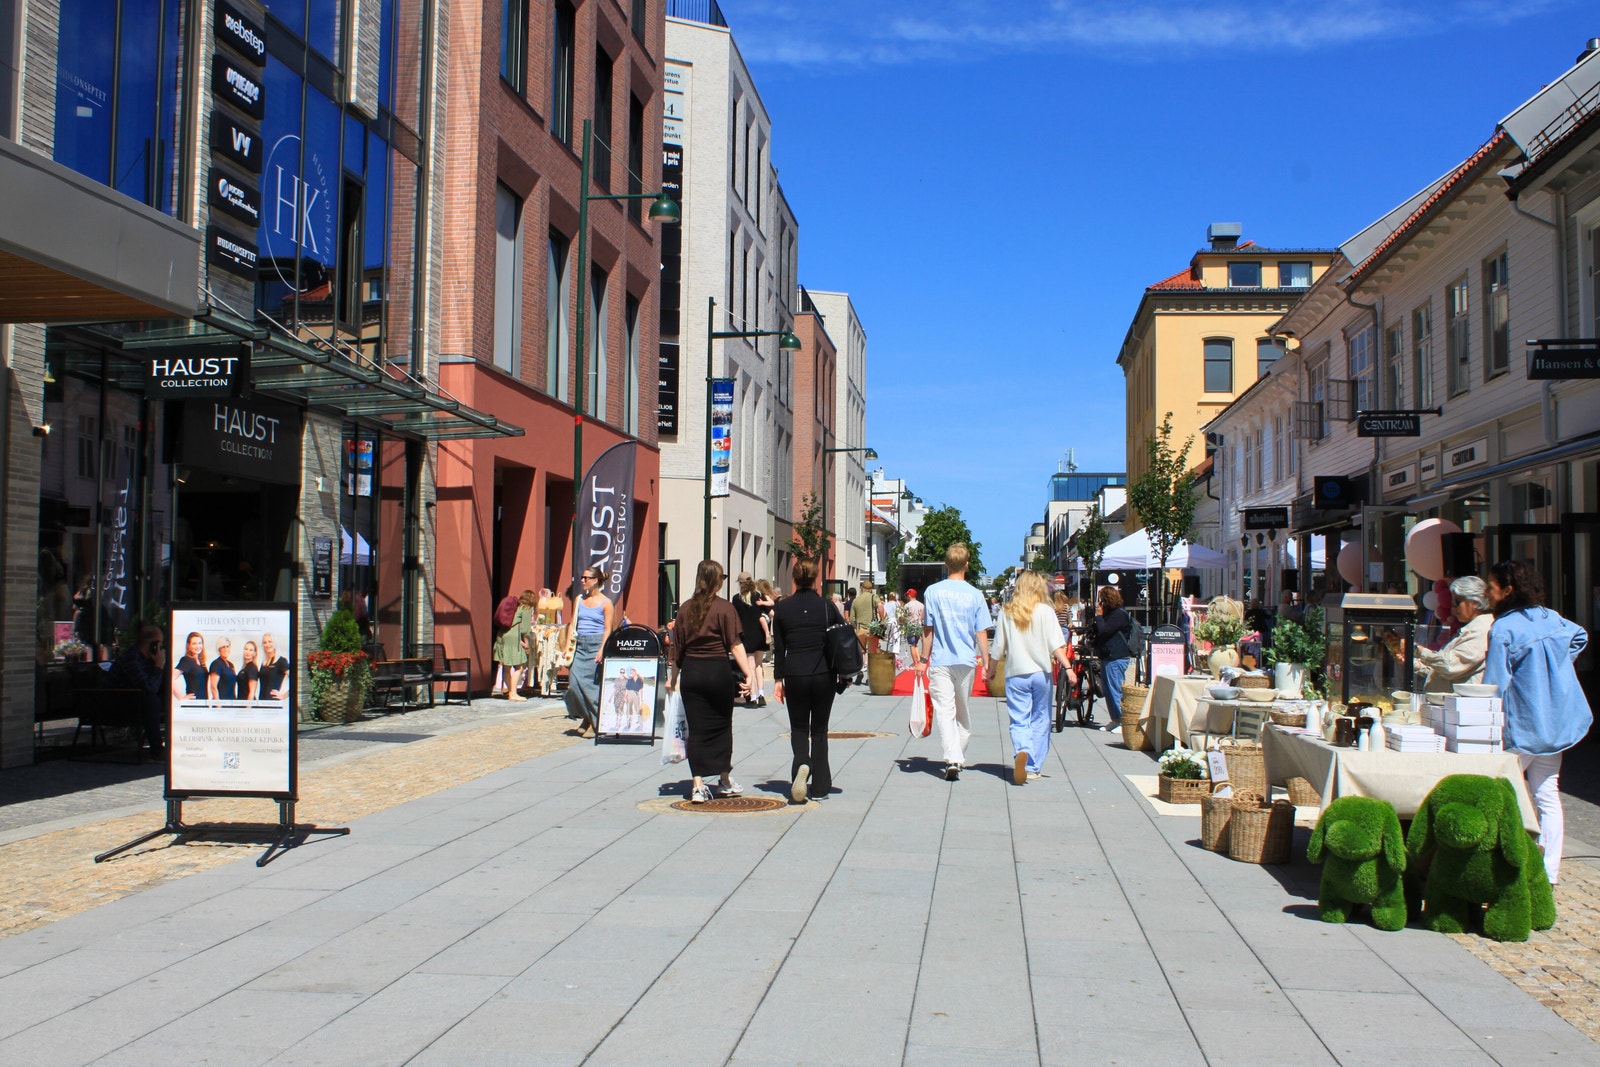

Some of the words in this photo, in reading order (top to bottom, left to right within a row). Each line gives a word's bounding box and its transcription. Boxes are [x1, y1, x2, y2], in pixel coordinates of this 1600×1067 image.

[225, 13, 265, 56] webstep
[226, 67, 260, 101] UPHEADS
[668, 158, 679, 166] pris
[274, 164, 321, 255] HK
[217, 236, 257, 263] HUDKONSEPTET
[152, 357, 239, 377] HAUST
[1535, 358, 1581, 370] Hansen
[1583, 357, 1595, 369] &
[160, 378, 228, 388] COLLECTION
[213, 402, 280, 444] HAUST
[1363, 419, 1415, 431] CENTRUM
[220, 439, 273, 461] COLLECTION
[610, 493, 627, 594] COLLECTION
[196, 615, 267, 625] HUDKONSEPTET
[616, 639, 649, 647] HAUST
